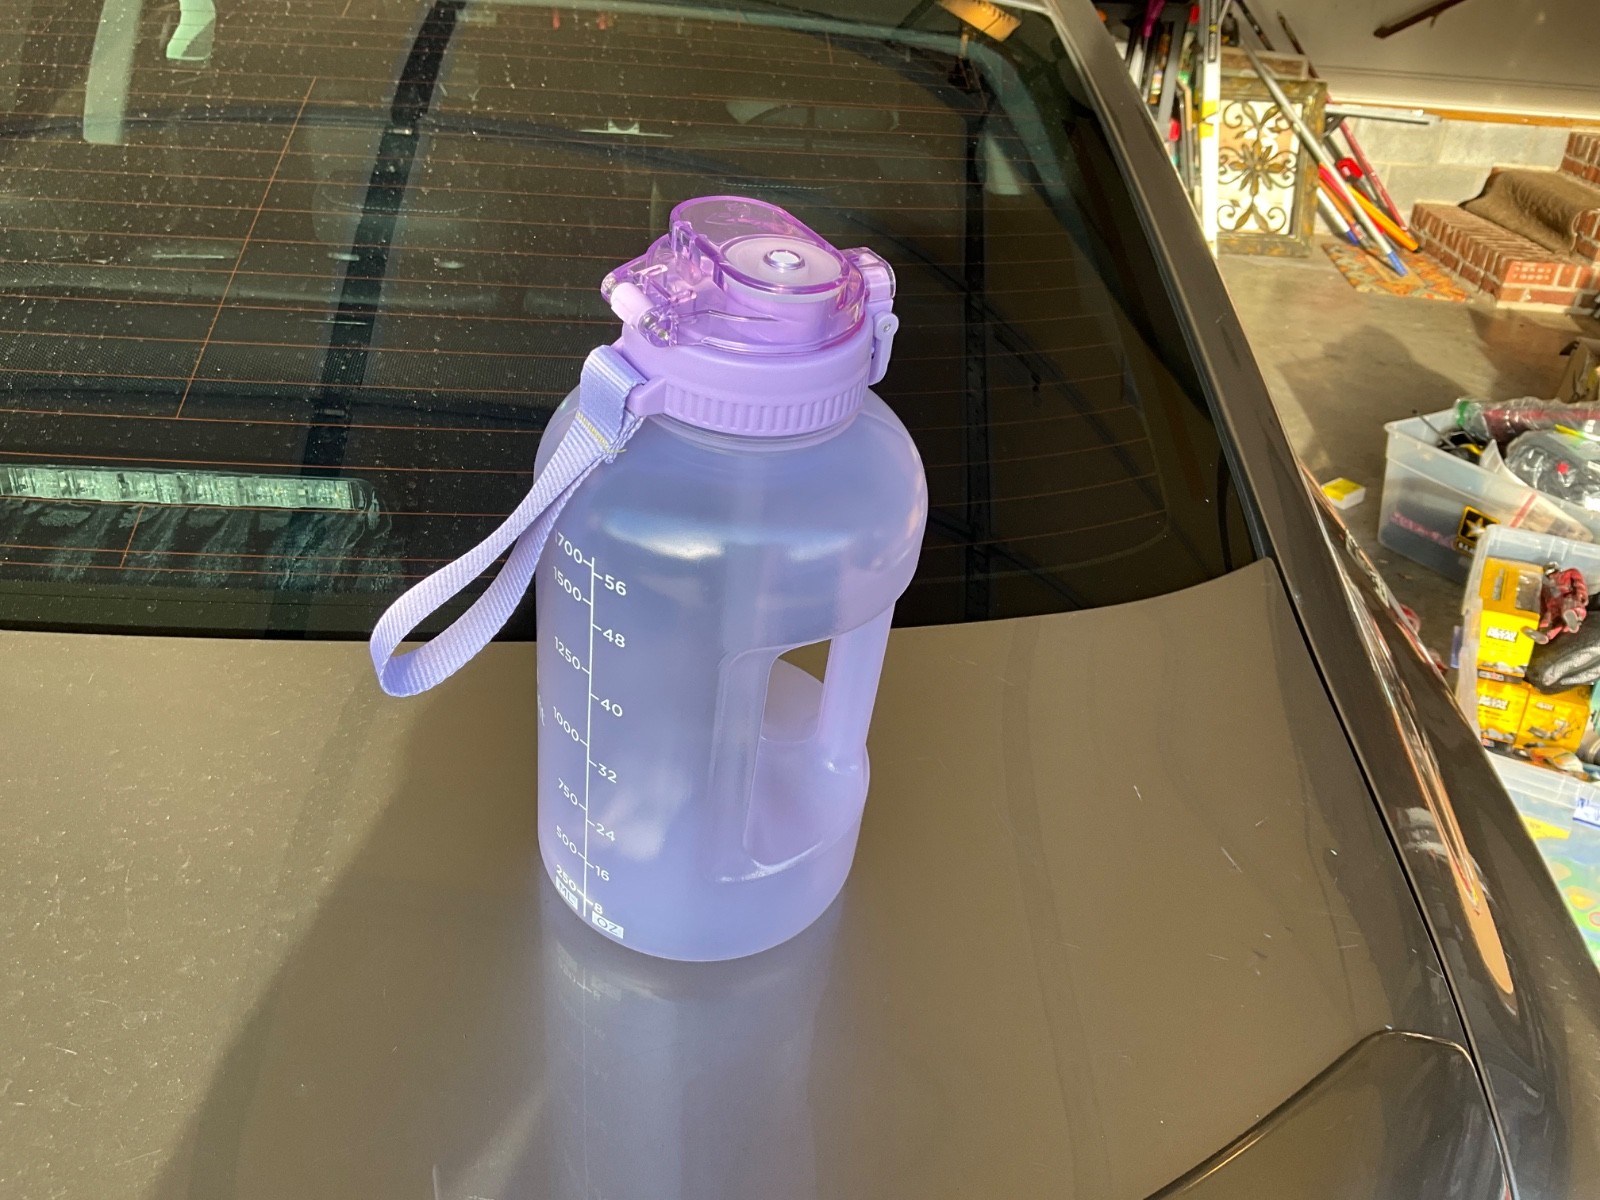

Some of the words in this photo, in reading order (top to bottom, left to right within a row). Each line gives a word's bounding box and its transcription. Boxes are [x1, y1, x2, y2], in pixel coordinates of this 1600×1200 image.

[553, 566, 582, 602] 1500
[604, 574, 627, 596] 56
[602, 629, 626, 648] 48
[554, 636, 581, 670] 1250
[600, 699, 623, 718] 40
[553, 706, 580, 742] 1000
[598, 763, 617, 784] 32
[558, 777, 578, 806] 750
[556, 825, 577, 854] 500
[596, 823, 616, 842] 24
[556, 864, 577, 892] 250
[595, 865, 610, 882] 16
[594, 902, 603, 915] 8
[596, 916, 619, 936] OZ
